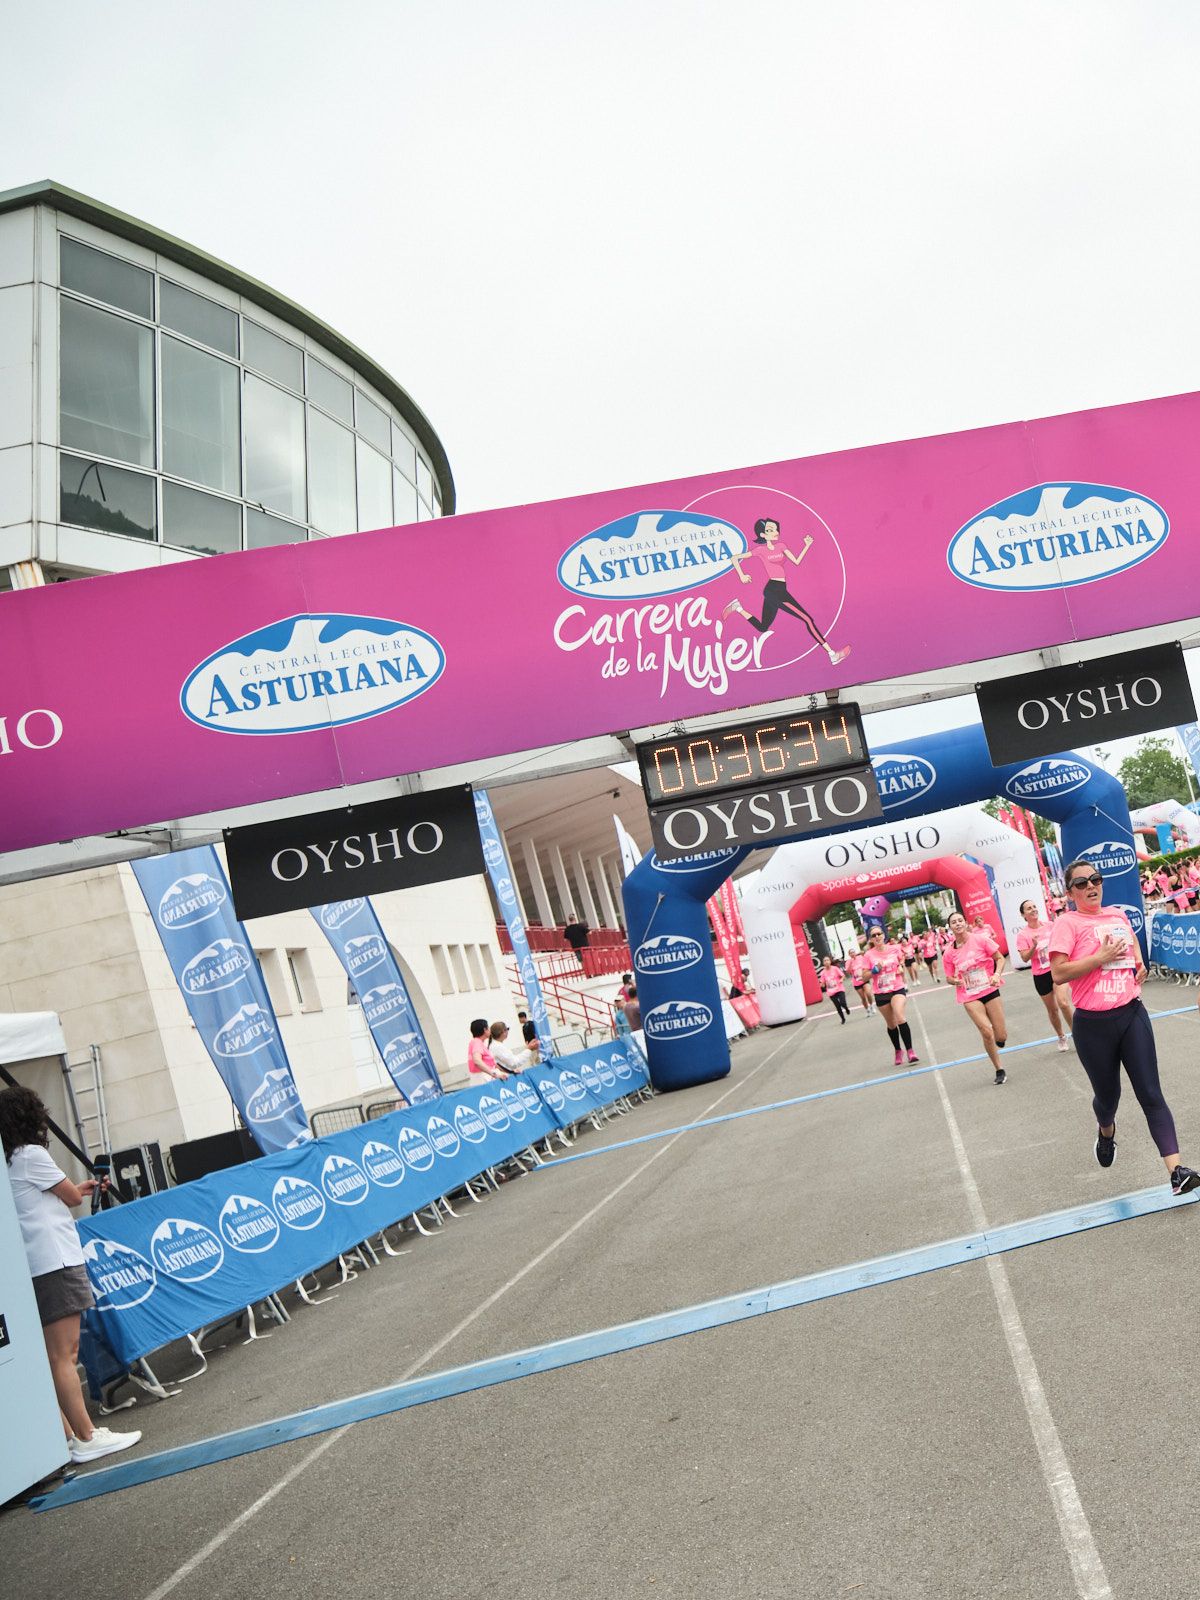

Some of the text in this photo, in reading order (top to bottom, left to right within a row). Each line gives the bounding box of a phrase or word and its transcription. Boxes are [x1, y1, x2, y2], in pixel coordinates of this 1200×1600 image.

[996, 505, 1142, 539] CENTRAL LECHERA
[599, 528, 724, 557] CENTRAL LECHERA
[969, 519, 1155, 575] ASTURIANA
[576, 540, 733, 587] ASTURIANA
[553, 596, 712, 651] Carrera
[239, 637, 413, 677] CENTRAL LECHERA
[602, 619, 775, 699] de la Mujer
[205, 653, 428, 718] ASTURIANA
[1017, 676, 1162, 731] OYSHO
[654, 716, 851, 793] 00:36:34
[1014, 769, 1086, 794] ASTURIANA
[663, 777, 868, 850] OYSHO
[271, 821, 444, 882] OYSHO
[825, 826, 940, 868] OYSHO
[975, 834, 1010, 848] OYSHO
[757, 882, 794, 894] OYSHO
[821, 876, 856, 891] Sports
[870, 861, 923, 880] Santander
[1003, 876, 1035, 890] OYSHO
[751, 931, 785, 944] OYSHO
[637, 949, 698, 967] ASTURIANA
[760, 978, 793, 991] OYSHO
[647, 1013, 709, 1034] ASTURIANA
[326, 1171, 367, 1199] ASTURIANA
[277, 1193, 323, 1223] ASTURIANA
[226, 1214, 277, 1246] ASTURIANA
[158, 1238, 221, 1273] ASTURIANA
